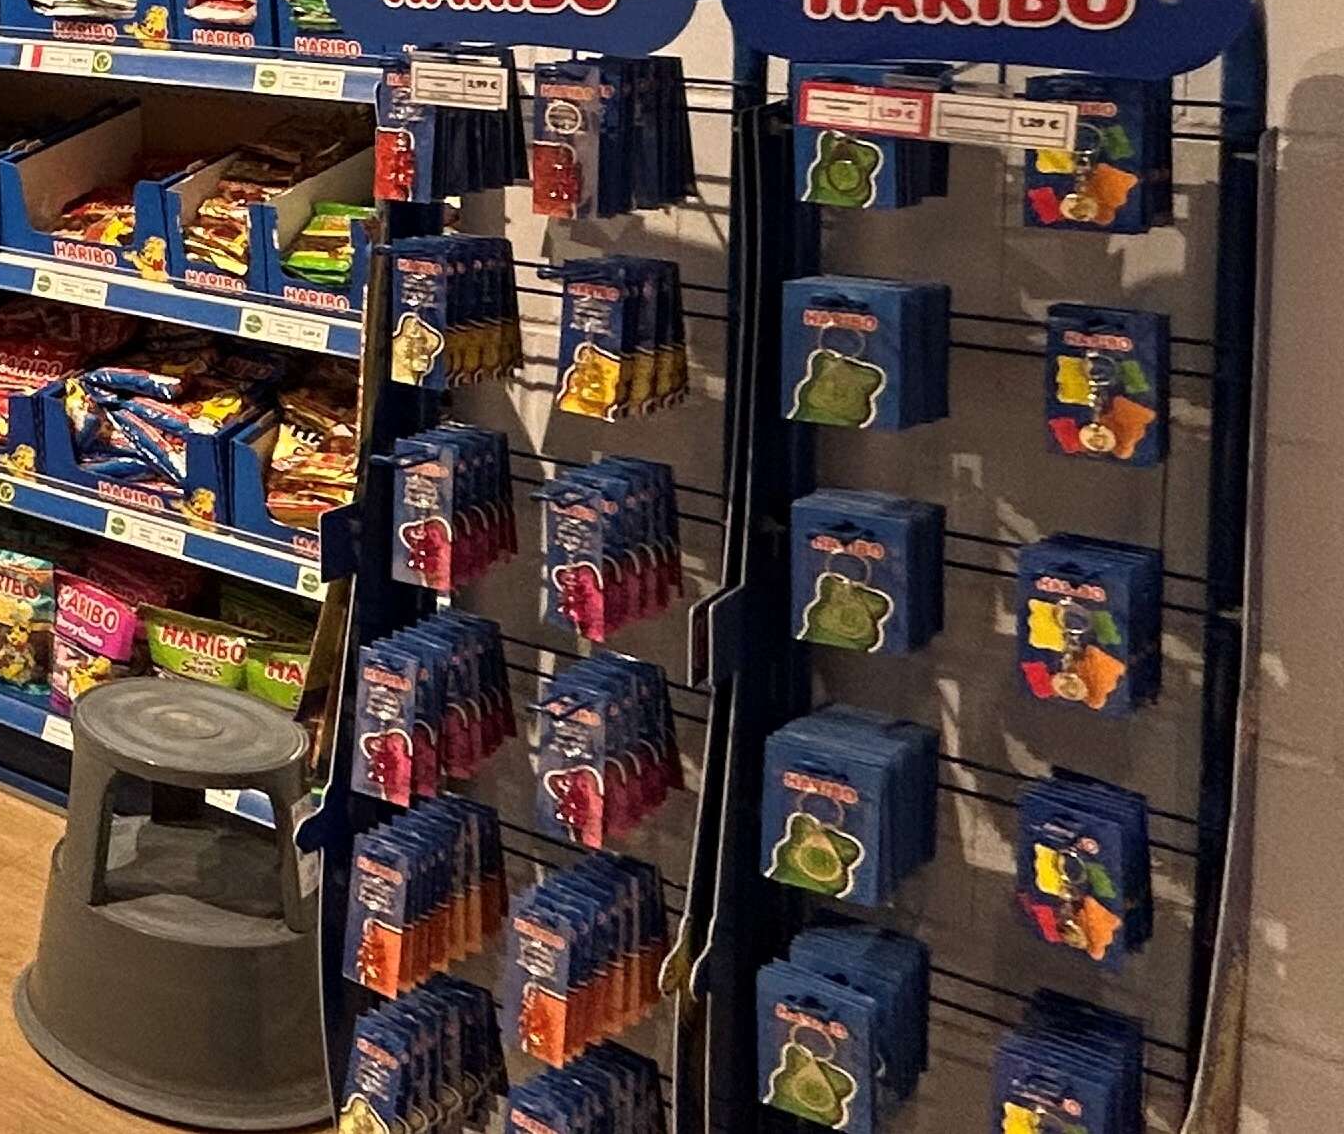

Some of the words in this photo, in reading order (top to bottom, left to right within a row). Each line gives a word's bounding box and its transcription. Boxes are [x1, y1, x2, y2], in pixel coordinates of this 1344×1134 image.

[193, 29, 255, 49] HARIBO
[295, 36, 362, 58] HARIBO
[54, 240, 117, 267] HARIBO
[283, 285, 349, 311] HARIBO
[160, 624, 249, 665] HARIBO
